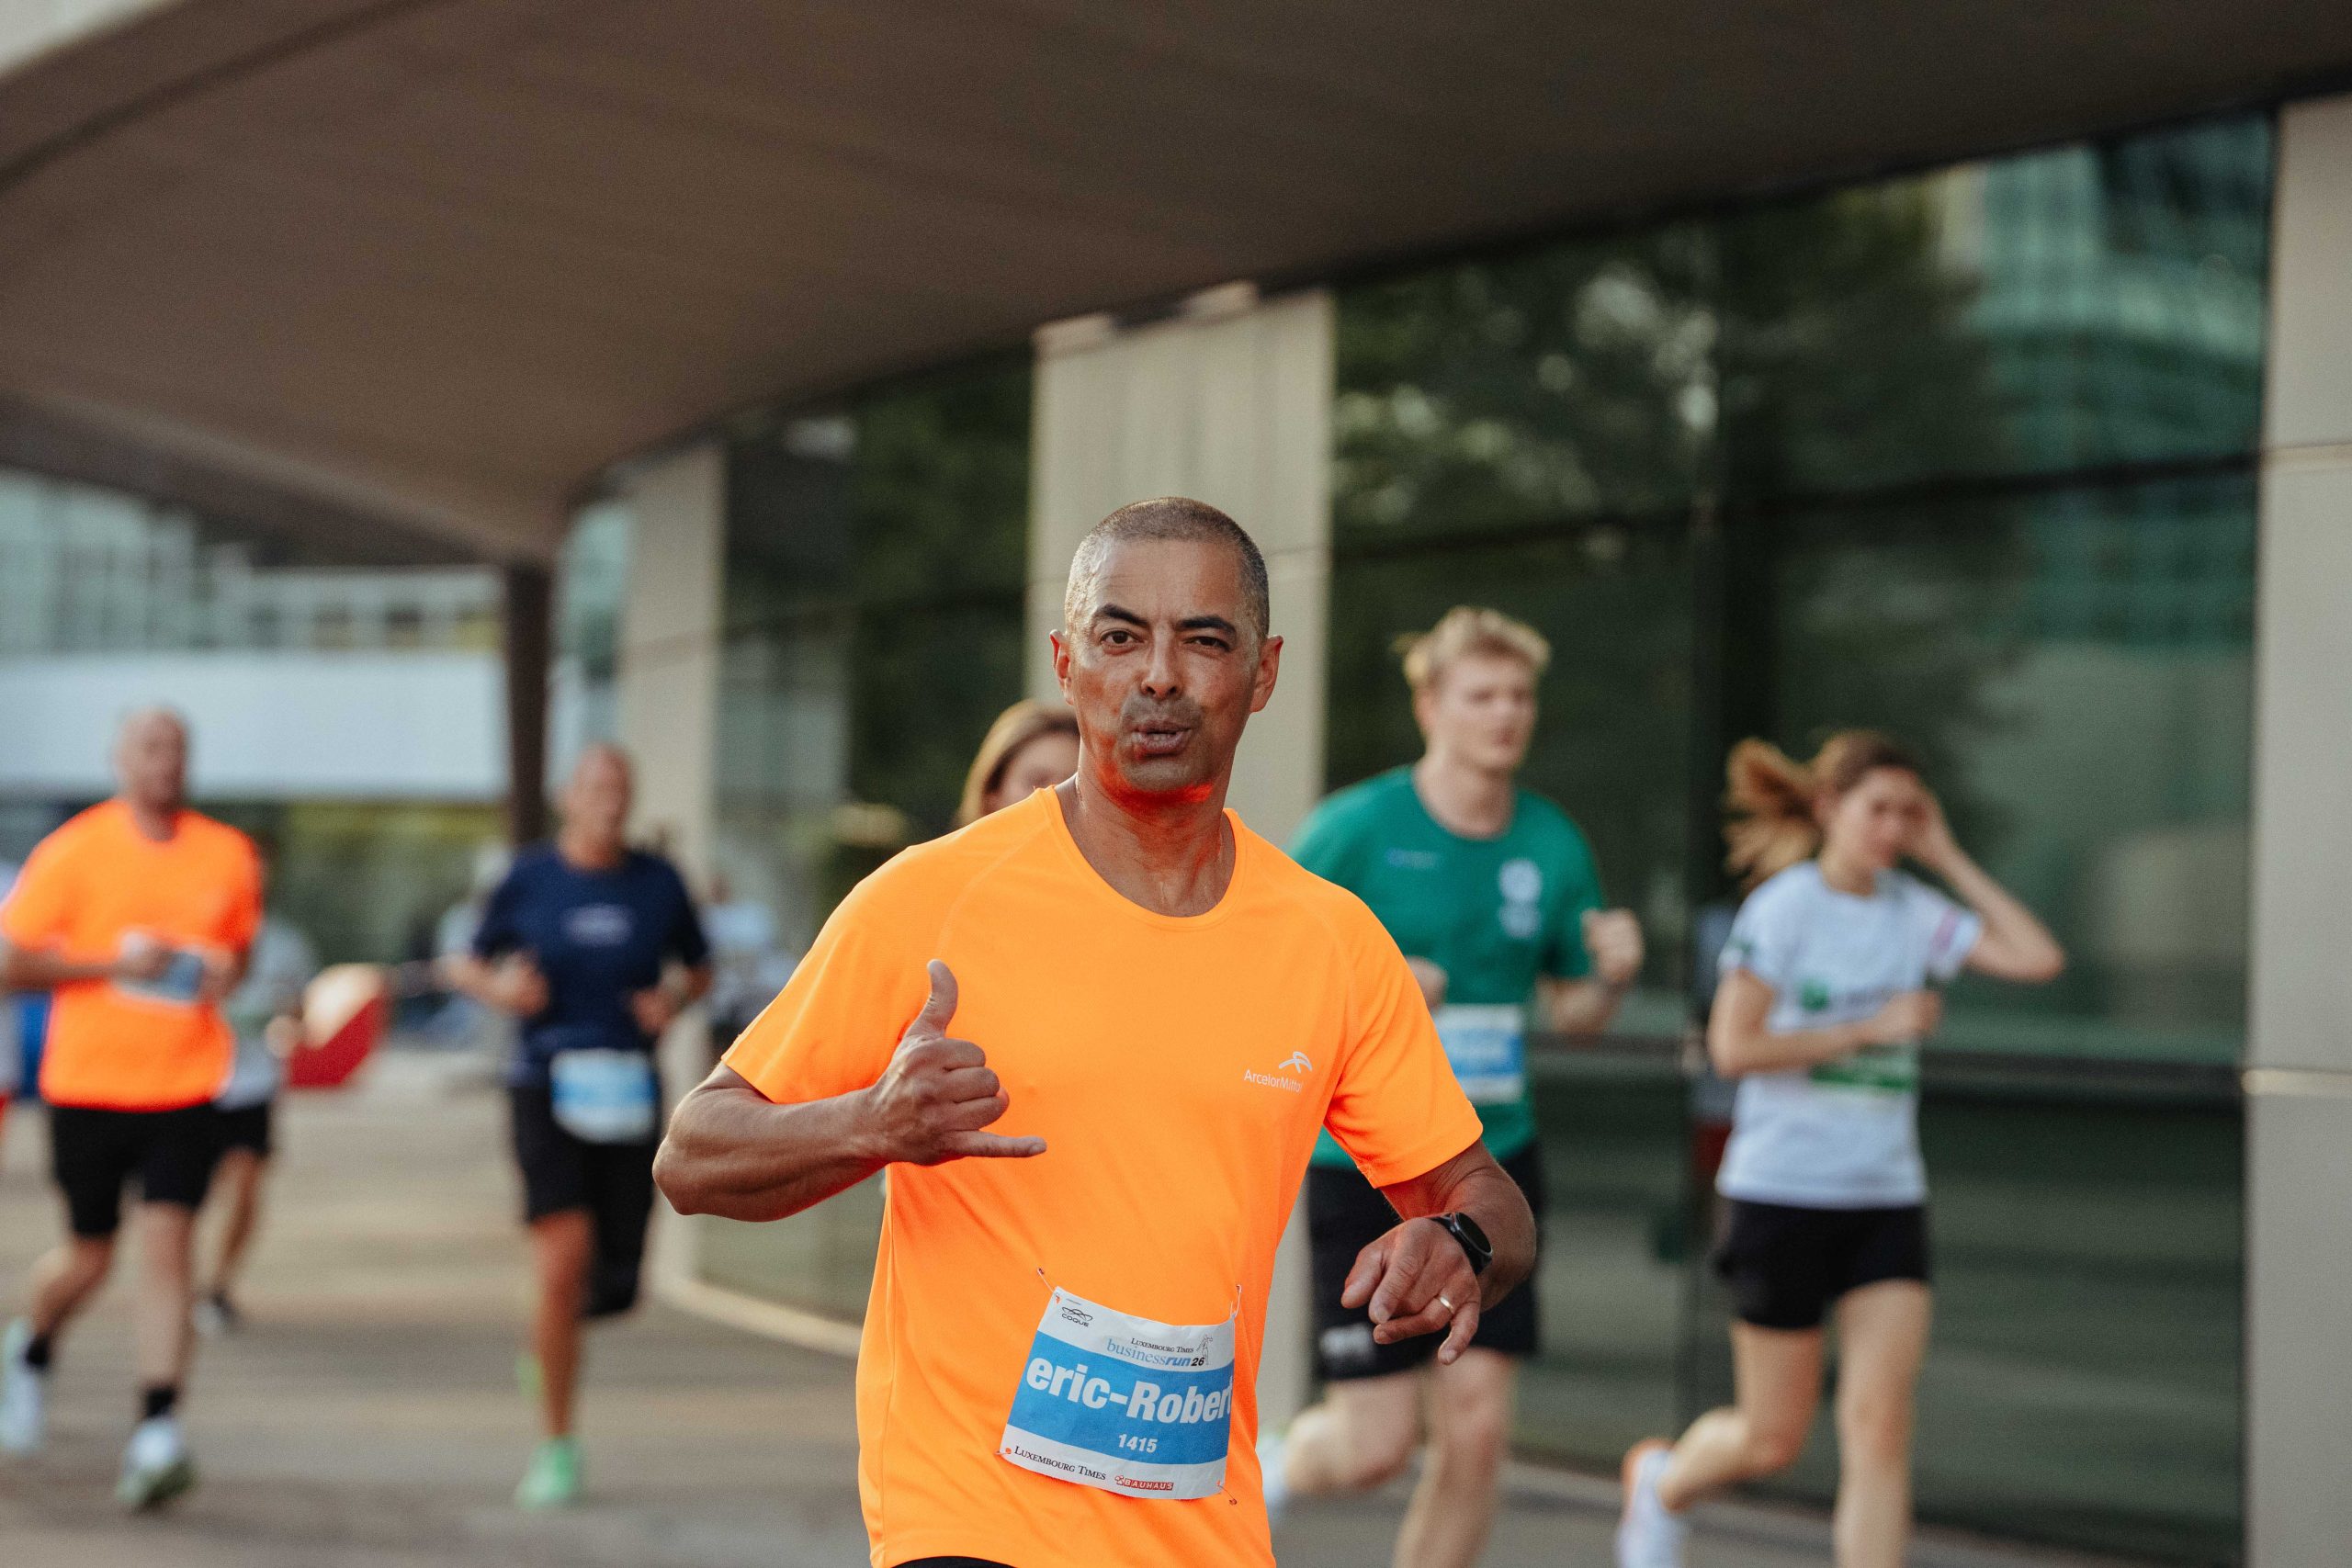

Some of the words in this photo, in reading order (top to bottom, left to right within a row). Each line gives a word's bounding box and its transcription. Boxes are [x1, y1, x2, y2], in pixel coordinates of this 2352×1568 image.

[1062, 1313, 1089, 1327] COQUE
[1131, 1337, 1175, 1352] LUXEMBOURG
[1191, 1357, 1205, 1367] 26
[1118, 1434, 1158, 1453] 1415
[1014, 1446, 1076, 1472] LUXEMBOURG
[1078, 1465, 1106, 1481] TIMES
[1124, 1477, 1174, 1491] BAUHAUS
